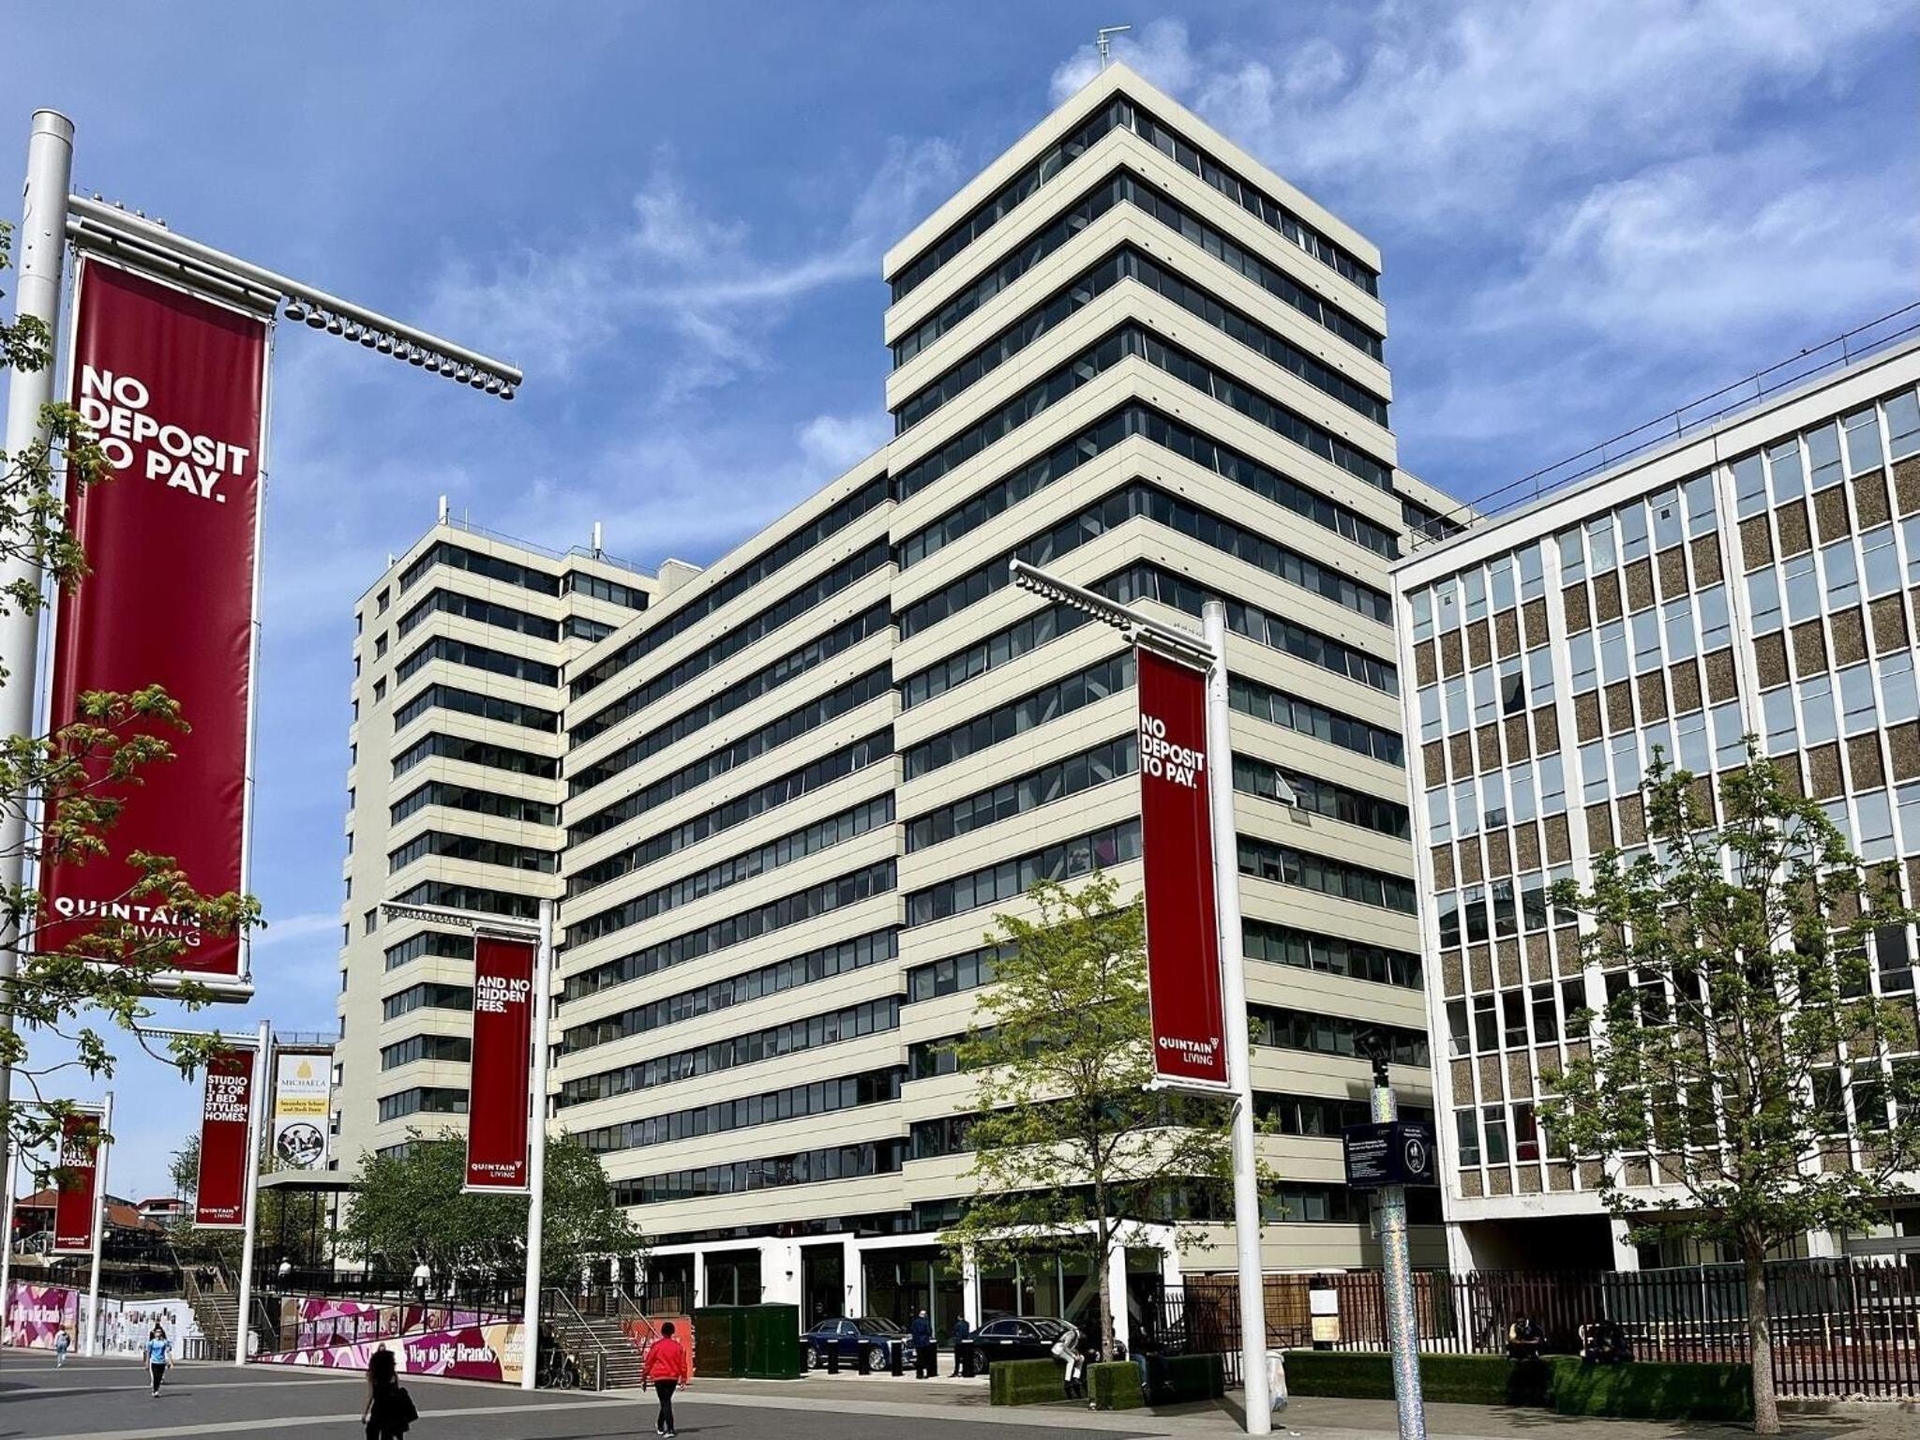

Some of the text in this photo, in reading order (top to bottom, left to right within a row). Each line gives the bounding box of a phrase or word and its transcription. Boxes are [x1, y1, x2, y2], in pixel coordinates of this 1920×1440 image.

[82, 364, 149, 409] NO
[79, 397, 249, 476] DEPOSIT
[146, 449, 226, 503] PAY.
[1141, 713, 1166, 738] NO
[1141, 733, 1205, 771] DEPOSIT
[1141, 753, 1197, 789] TO PAY.
[477, 976, 530, 991] AND NO
[477, 987, 525, 1003] HIDDEN
[476, 999, 507, 1013] FEES.
[1159, 1036, 1212, 1053] QUINTAIN
[1183, 1051, 1213, 1065] LIVING
[208, 1075, 247, 1086] STUDIO
[217, 1085, 225, 1094] 2
[227, 1085, 245, 1095] OR
[206, 1094, 237, 1103] 3 BED
[205, 1102, 248, 1113] STYLISH
[205, 1111, 247, 1122] HOMES.
[471, 1163, 515, 1171] QUINTAIN
[409, 1344, 426, 1367] Way
[429, 1346, 439, 1362] to
[440, 1343, 455, 1369] Big
[457, 1342, 493, 1362] Brands
